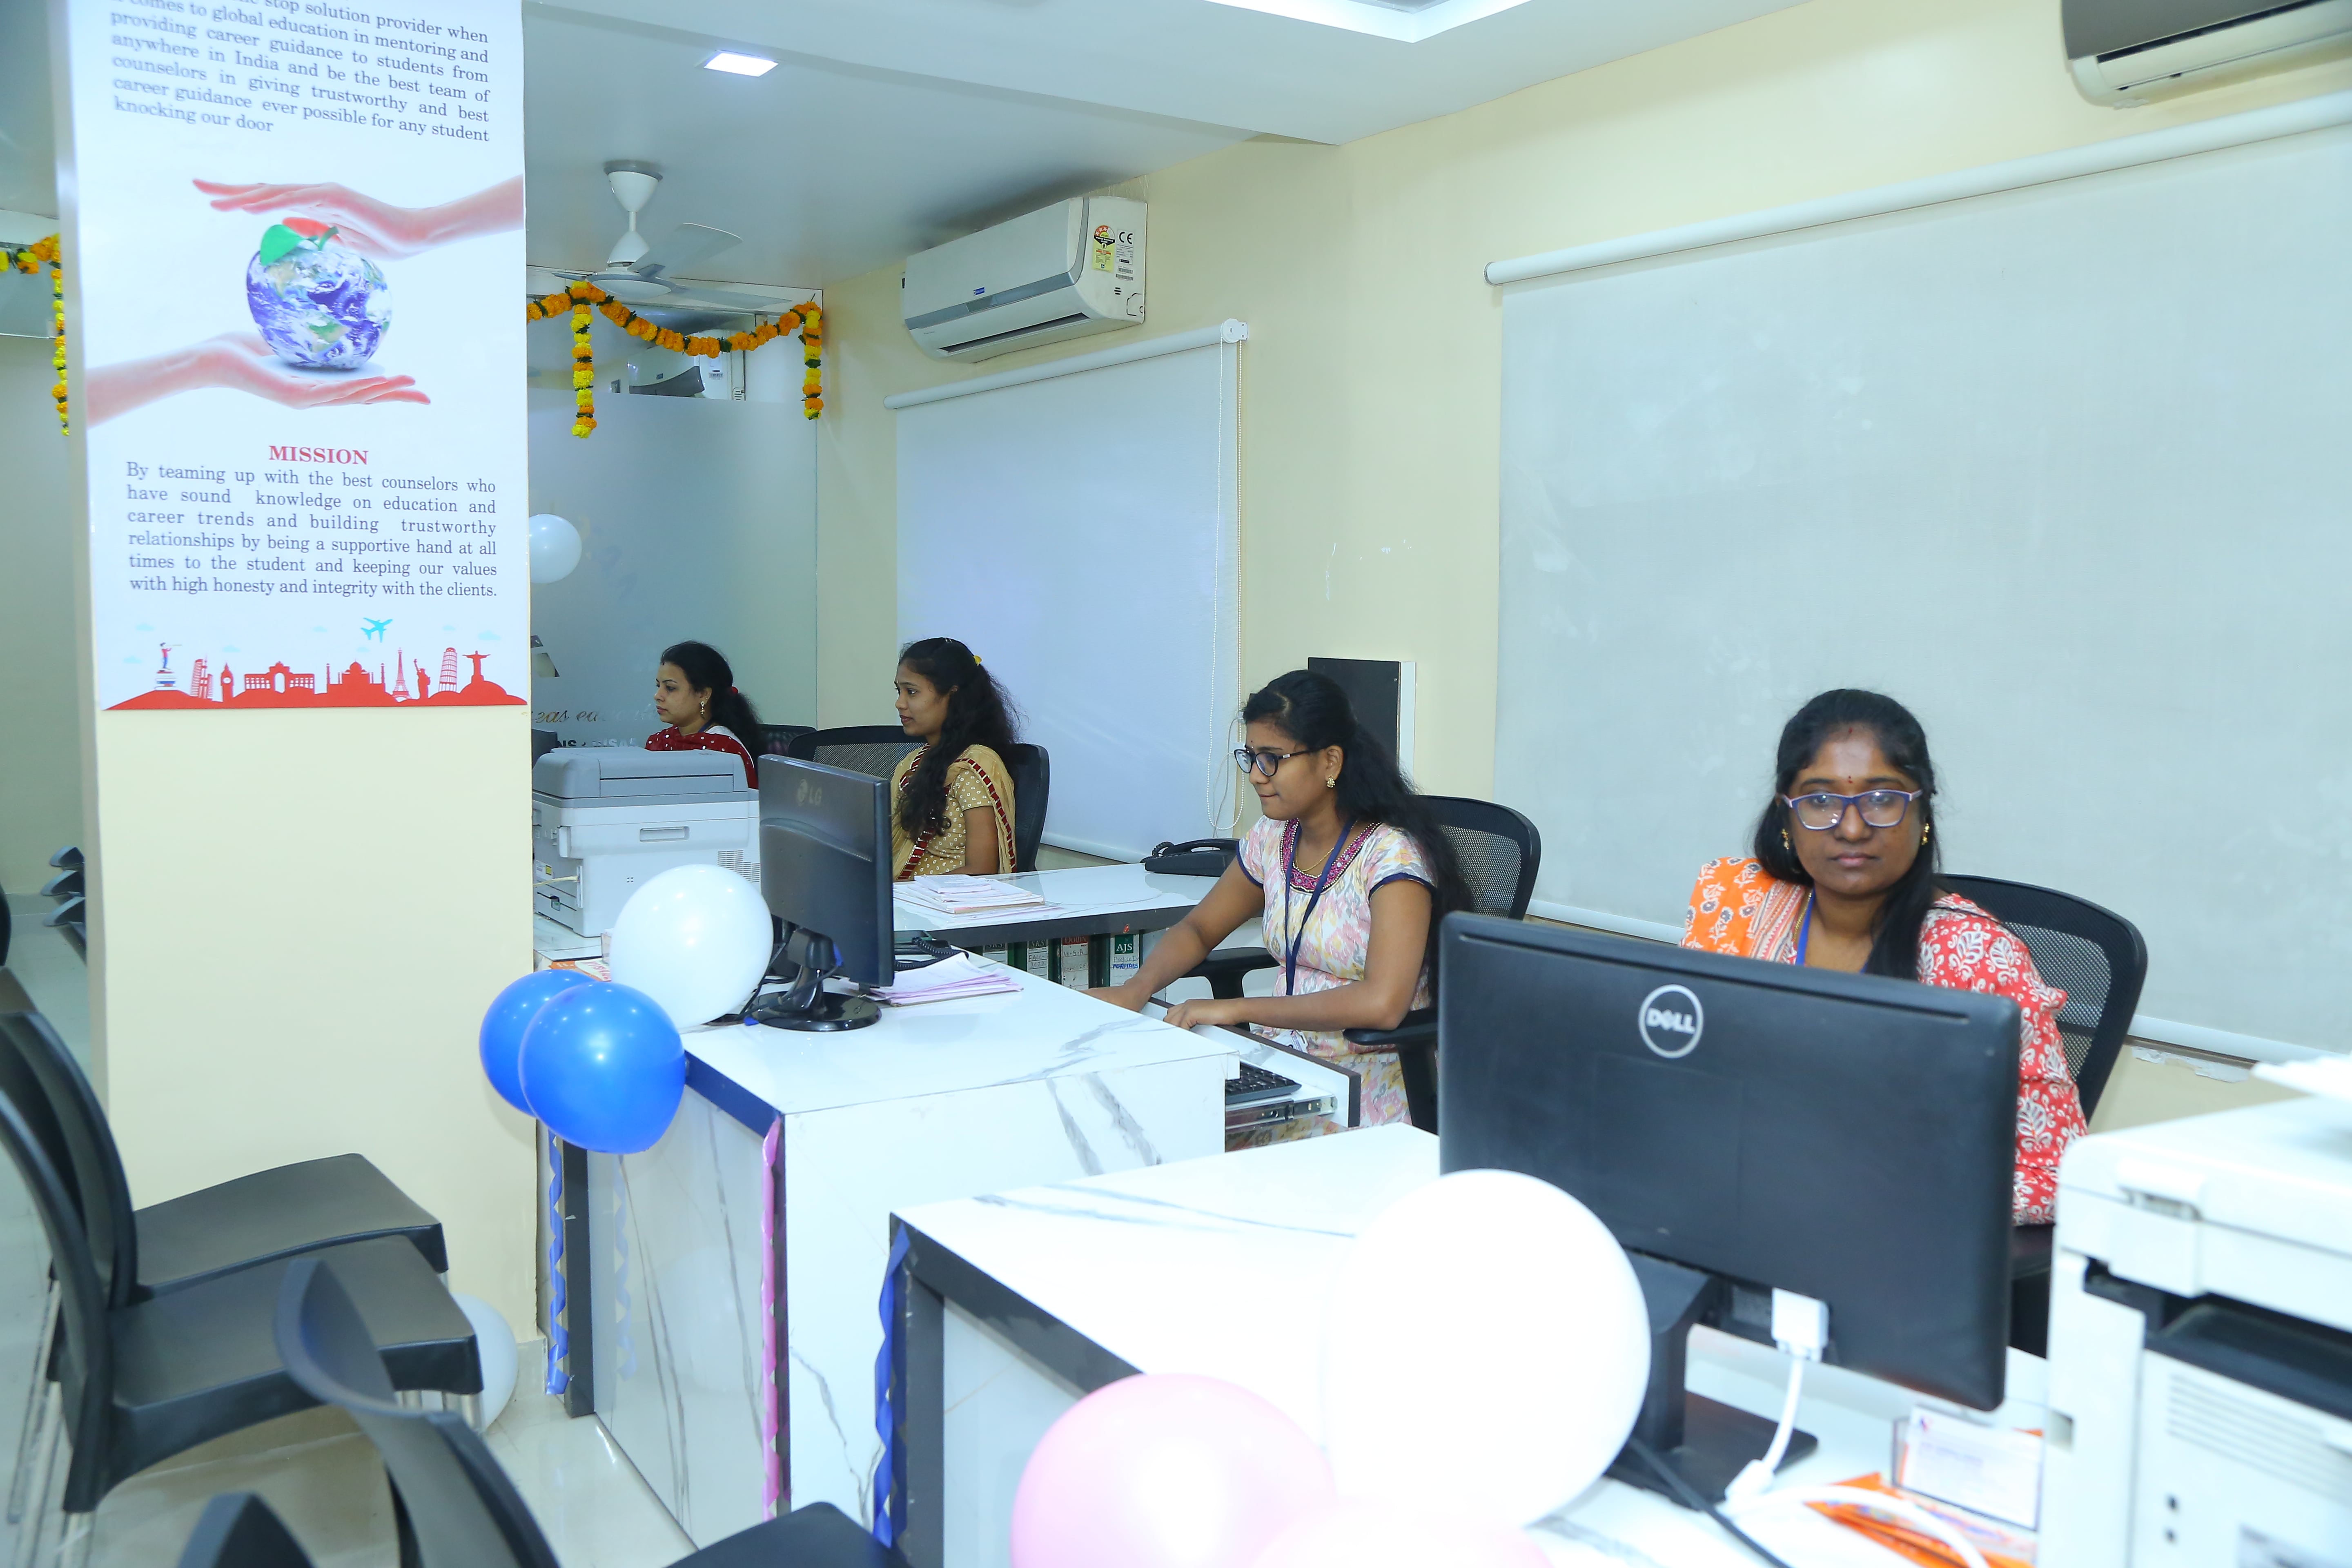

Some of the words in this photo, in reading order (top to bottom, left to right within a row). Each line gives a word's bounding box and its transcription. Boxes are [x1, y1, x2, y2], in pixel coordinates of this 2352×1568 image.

[189, 3, 207, 16] to
[212, 5, 263, 26] global
[268, 16, 349, 40] education
[354, 29, 370, 44] in
[374, 36, 457, 61] mentoring
[460, 49, 489, 63] and
[265, 0, 300, 14] stop
[305, 2, 370, 24] solution
[376, 16, 442, 35] provider
[447, 25, 488, 43] when
[111, 12, 197, 39] providing
[206, 29, 260, 46] career
[270, 38, 343, 60] guidance
[352, 50, 368, 64] to
[377, 56, 444, 76] students
[452, 65, 489, 82] from
[111, 34, 200, 58] anywhere
[209, 47, 225, 62] in
[236, 50, 280, 71] India
[288, 62, 318, 77] and
[327, 65, 346, 81] be
[354, 70, 380, 86] the
[389, 74, 420, 92] best
[428, 82, 467, 99] team
[474, 89, 490, 102] of
[111, 56, 207, 80] counselors
[220, 69, 236, 85] in
[249, 75, 301, 98] giving
[311, 86, 408, 113] trustworthy
[419, 102, 448, 116] and
[459, 105, 489, 122] best
[112, 78, 170, 96] career
[175, 87, 252, 108] guidance
[262, 101, 298, 114] ever
[303, 107, 367, 125] possible
[371, 113, 394, 128] for
[399, 120, 427, 136] any
[432, 123, 489, 141] student
[115, 95, 197, 125] knocking
[201, 113, 231, 126] our
[236, 114, 274, 131] door
[1118, 232, 1133, 245] CE
[269, 445, 368, 464] MISSION
[127, 461, 149, 481] By
[158, 465, 226, 484] teaming
[234, 471, 255, 486] up
[264, 469, 299, 484] with
[308, 470, 333, 486] the
[343, 471, 373, 487] best
[382, 476, 458, 491] counselors
[466, 478, 496, 492] who
[127, 484, 168, 501] have
[181, 488, 232, 503] sound
[256, 490, 341, 510] knowledge
[353, 498, 372, 509] on
[383, 495, 458, 512] education
[469, 499, 496, 513] and
[127, 512, 185, 523] career
[197, 511, 254, 526] trends
[267, 512, 298, 528] and
[310, 514, 379, 534] building
[401, 519, 497, 537] trustworthy
[128, 530, 234, 551] relationships
[242, 533, 261, 552] by
[268, 534, 310, 553] being
[316, 540, 325, 550] a
[332, 538, 410, 555] supportive
[416, 539, 453, 554] hand
[459, 541, 473, 554] at
[479, 540, 497, 555] all
[129, 553, 174, 568] times
[185, 556, 201, 569] to
[211, 554, 237, 570] the
[247, 556, 306, 571] student
[315, 557, 343, 572] and
[353, 558, 411, 577] keeping
[419, 564, 444, 575] our
[452, 561, 497, 575] values
[129, 575, 167, 590] with
[172, 576, 208, 595] high
[213, 576, 275, 596] honesty
[279, 578, 308, 593] and
[312, 579, 378, 597] integrity
[382, 581, 415, 595] with
[419, 581, 443, 595] the
[447, 581, 497, 596] clients.
[1116, 943, 1132, 953] AJS
[1646, 1007, 1696, 1035] DELL
